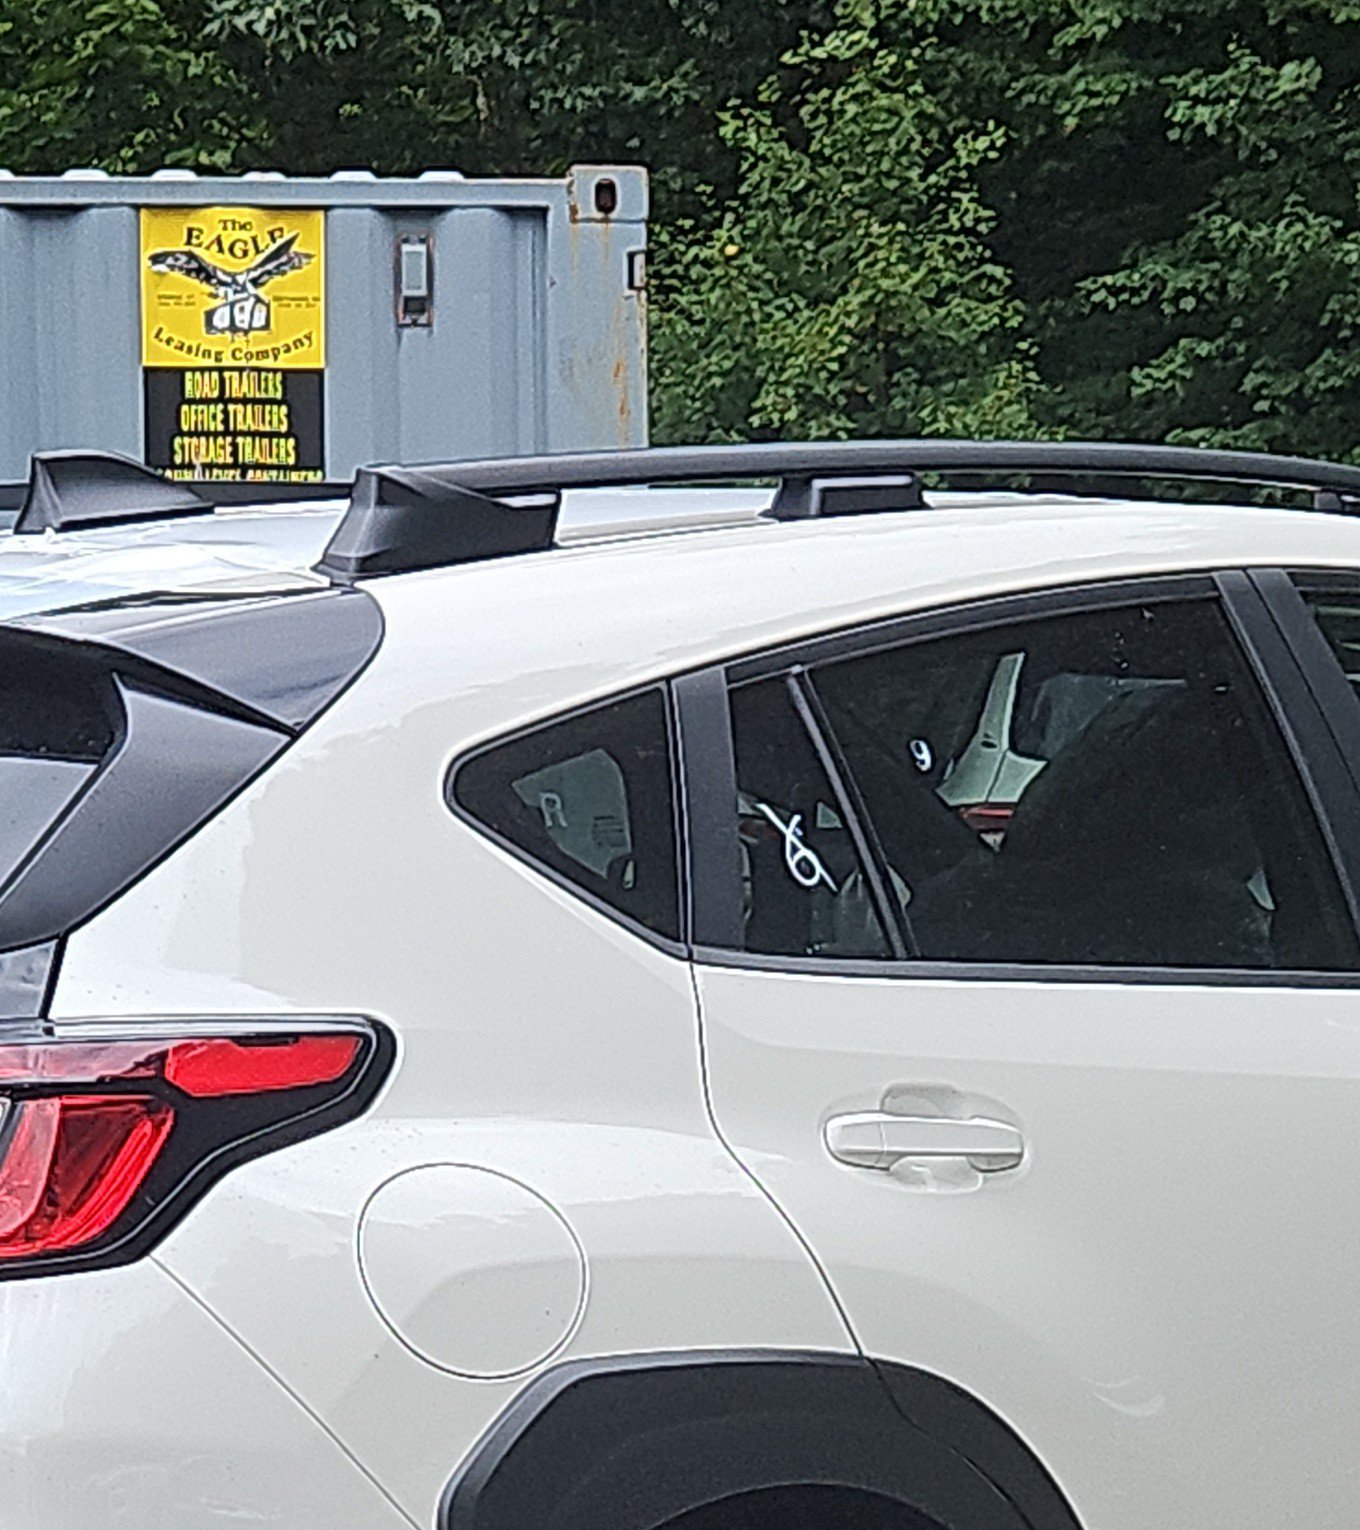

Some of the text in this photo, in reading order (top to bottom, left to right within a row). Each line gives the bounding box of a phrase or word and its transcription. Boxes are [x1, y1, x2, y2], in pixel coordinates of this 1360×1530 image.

[219, 219, 253, 232] The
[184, 227, 285, 259] EAGLE
[153, 327, 314, 362] Leasing Company
[185, 371, 283, 399] ROAD TRAILERS
[180, 404, 288, 432] OFFICE TRAILERS
[173, 436, 296, 465] STORAGE TRAILERS
